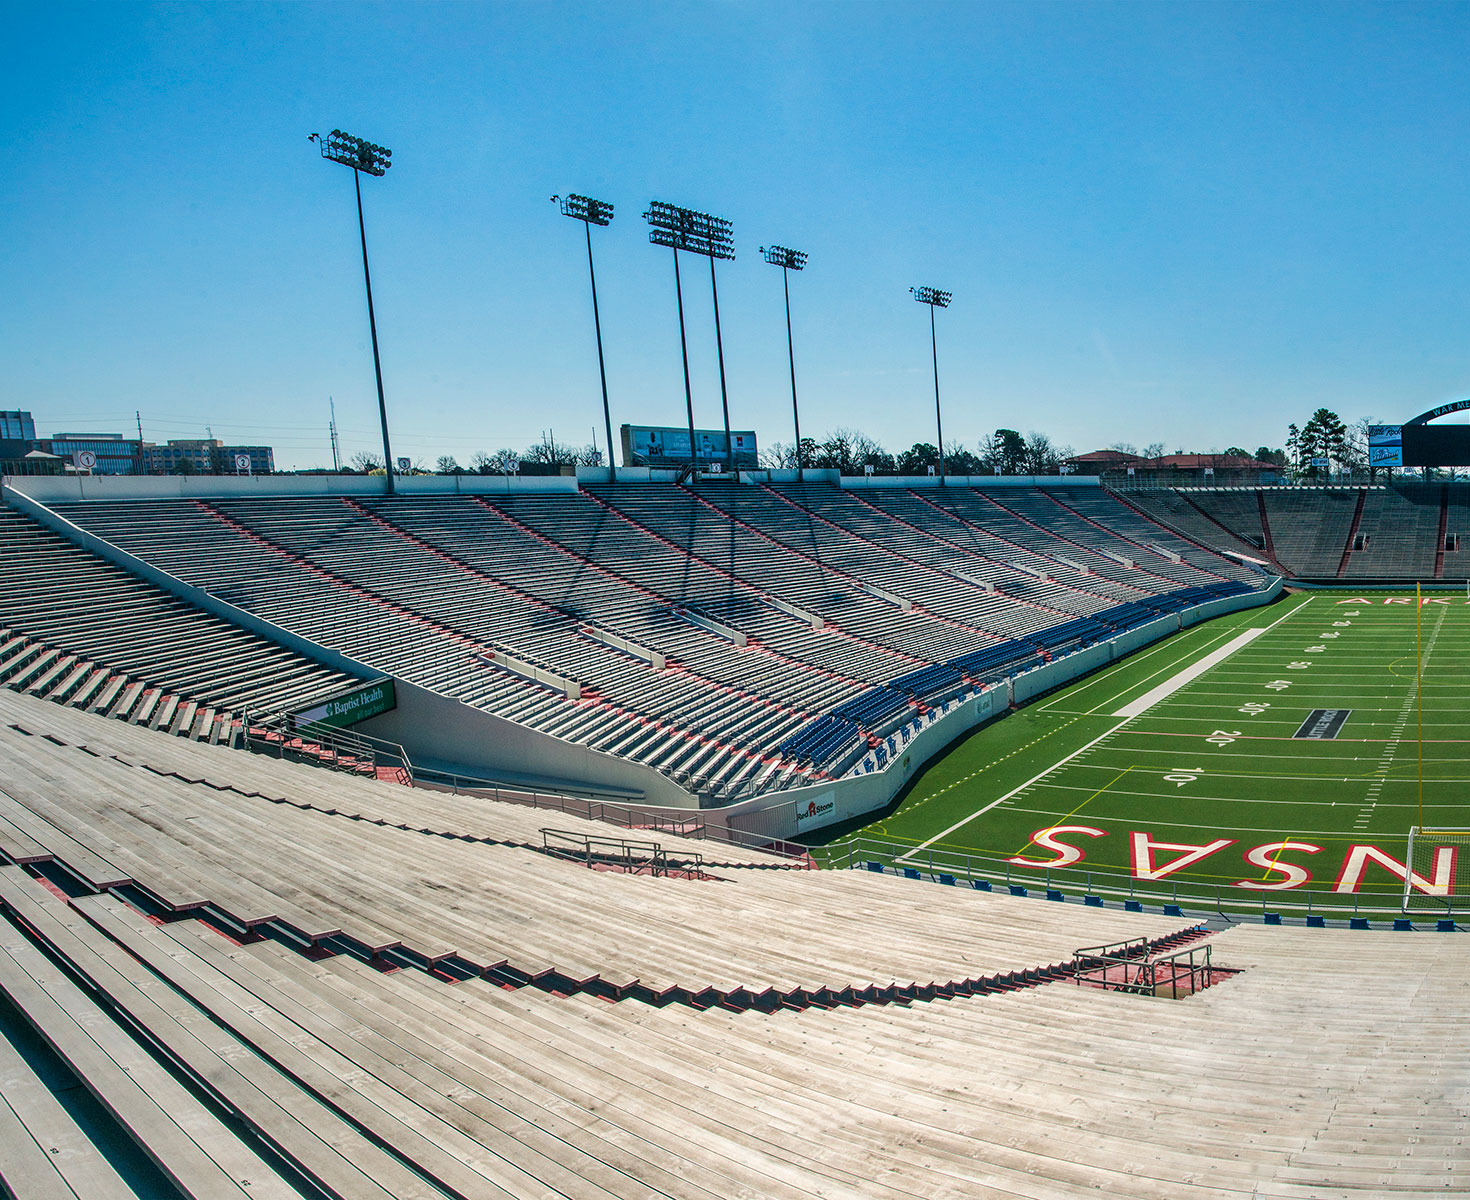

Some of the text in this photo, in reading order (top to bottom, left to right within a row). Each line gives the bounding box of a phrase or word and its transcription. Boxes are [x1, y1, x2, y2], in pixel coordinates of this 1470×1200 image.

[1433, 404, 1454, 416] WAR
[334, 687, 384, 715] Baptist Health
[1238, 702, 1271, 713] 30
[1205, 730, 1242, 743] 20
[1163, 767, 1205, 782] 10
[816, 802, 833, 813] Stone
